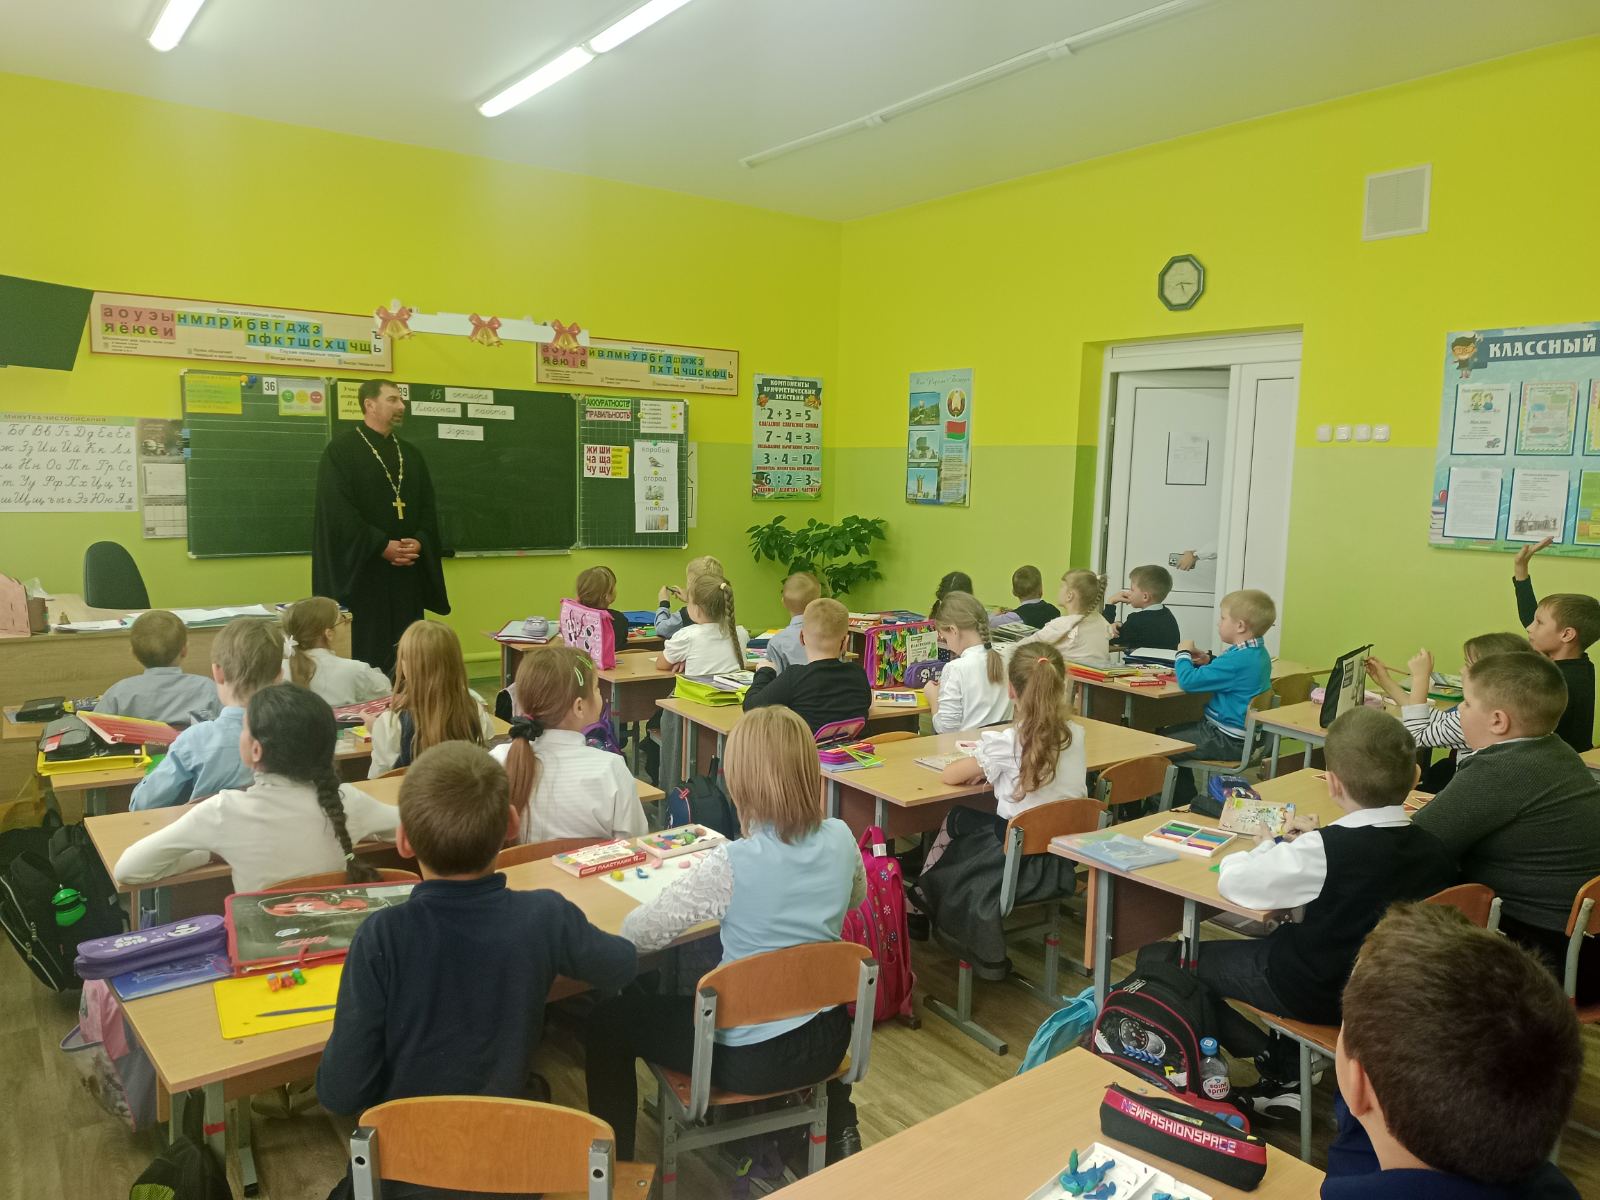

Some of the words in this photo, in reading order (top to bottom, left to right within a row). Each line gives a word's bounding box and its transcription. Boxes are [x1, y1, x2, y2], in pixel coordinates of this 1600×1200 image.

[1489, 334, 1597, 358] КЛАССНЫЙ
[264, 381, 276, 392] 36
[586, 399, 630, 408] АККУРАТНОСТЬ
[586, 410, 632, 420] ПРАВИЛЬНОСТЬ
[766, 408, 774, 420] 2
[785, 408, 792, 420] 3
[804, 409, 812, 421] 5
[765, 430, 773, 442] 7
[785, 431, 793, 443] 4
[805, 432, 812, 443] 3
[586, 455, 597, 464] ча
[599, 455, 611, 466] ща
[763, 452, 771, 465] 3
[781, 453, 789, 465] 4
[802, 453, 813, 465] 12
[586, 465, 597, 475] чу
[599, 465, 611, 476] щу
[764, 473, 772, 485] 6
[786, 474, 793, 486] 2
[805, 474, 812, 486] 3
[1120, 1097, 1237, 1154] NEWFASHIONSPACE
